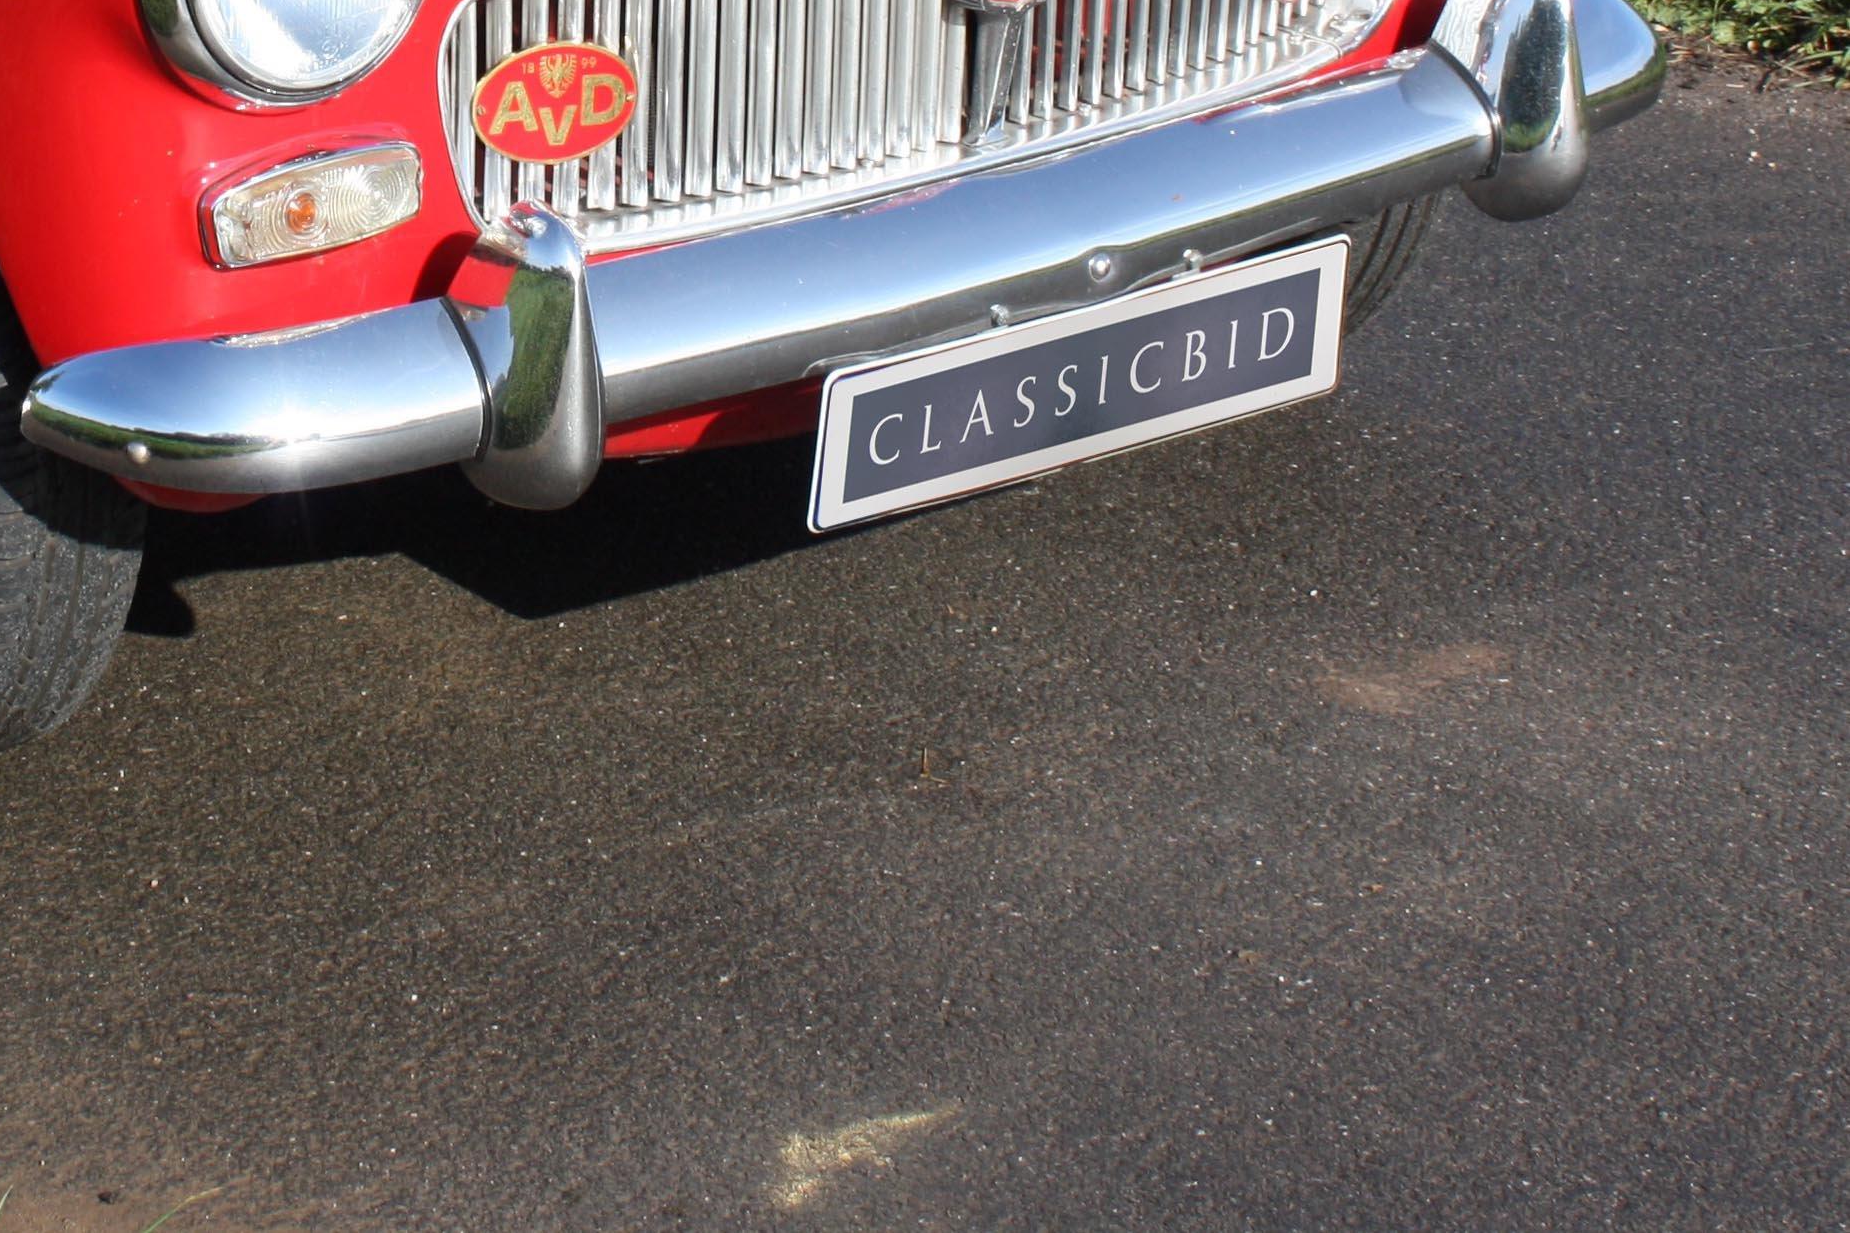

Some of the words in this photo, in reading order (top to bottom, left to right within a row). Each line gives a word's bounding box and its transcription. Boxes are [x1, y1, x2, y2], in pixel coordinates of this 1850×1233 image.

[521, 62, 535, 75] 18
[581, 56, 597, 69] 99
[867, 306, 1296, 466] CLASSICBID
